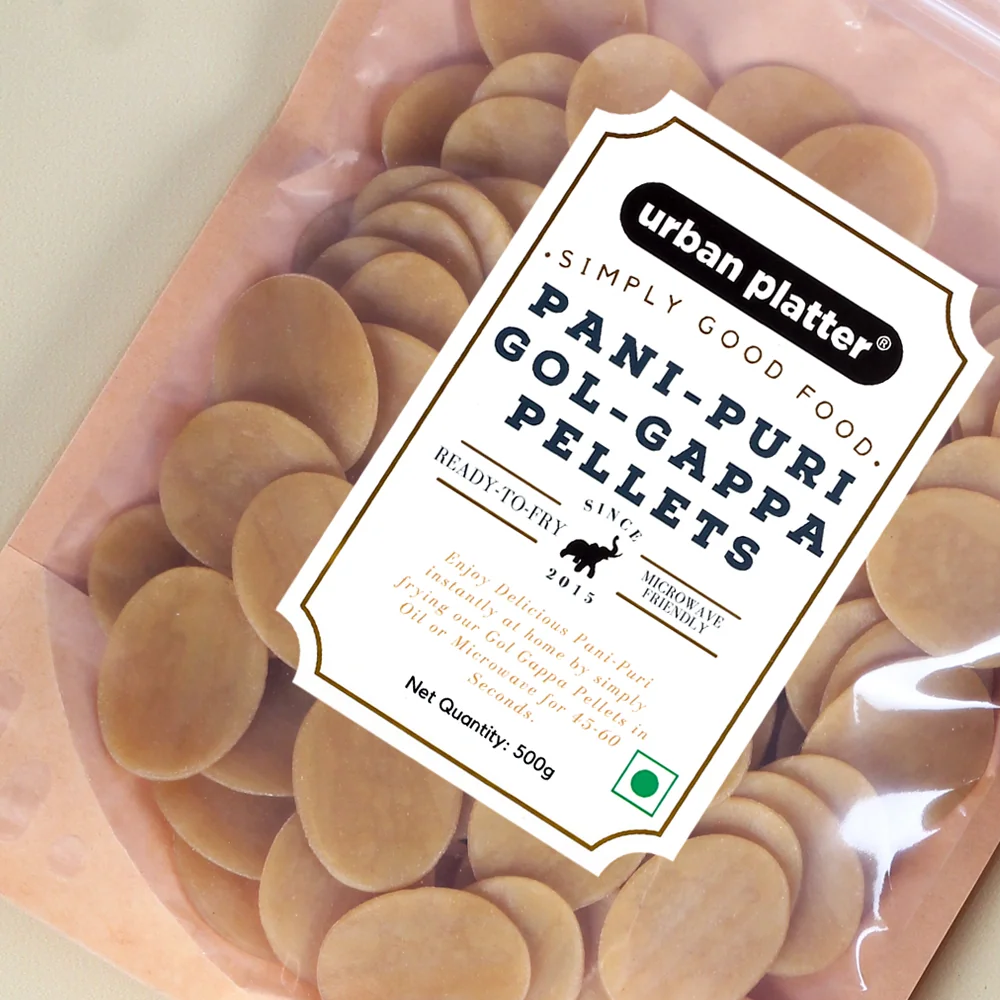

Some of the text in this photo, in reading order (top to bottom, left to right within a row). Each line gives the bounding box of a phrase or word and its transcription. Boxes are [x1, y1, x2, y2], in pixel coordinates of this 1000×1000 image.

[638, 201, 744, 283] urban
[527, 281, 857, 507] PANI-PURI
[697, 315, 784, 380] GOOD
[433, 444, 568, 537] READY-TO-FRY
[493, 325, 826, 559] GOL-GAPPA
[503, 393, 761, 572] PELLETS
[583, 498, 643, 543] SINCE
[444, 551, 655, 689] Enjoy Delicious Pani-Puri
[545, 567, 596, 604] 2015
[640, 569, 725, 629] MICROWAVE
[641, 587, 710, 635] FRIENDLY
[392, 575, 648, 741] frying our Gol Gappa Pellets in
[399, 601, 622, 747] Oil or Microwave for 45-60
[424, 565, 647, 713] instantly at home by simply
[404, 674, 556, 782] Net Quantity: 500g
[466, 671, 534, 723] Seconds.
